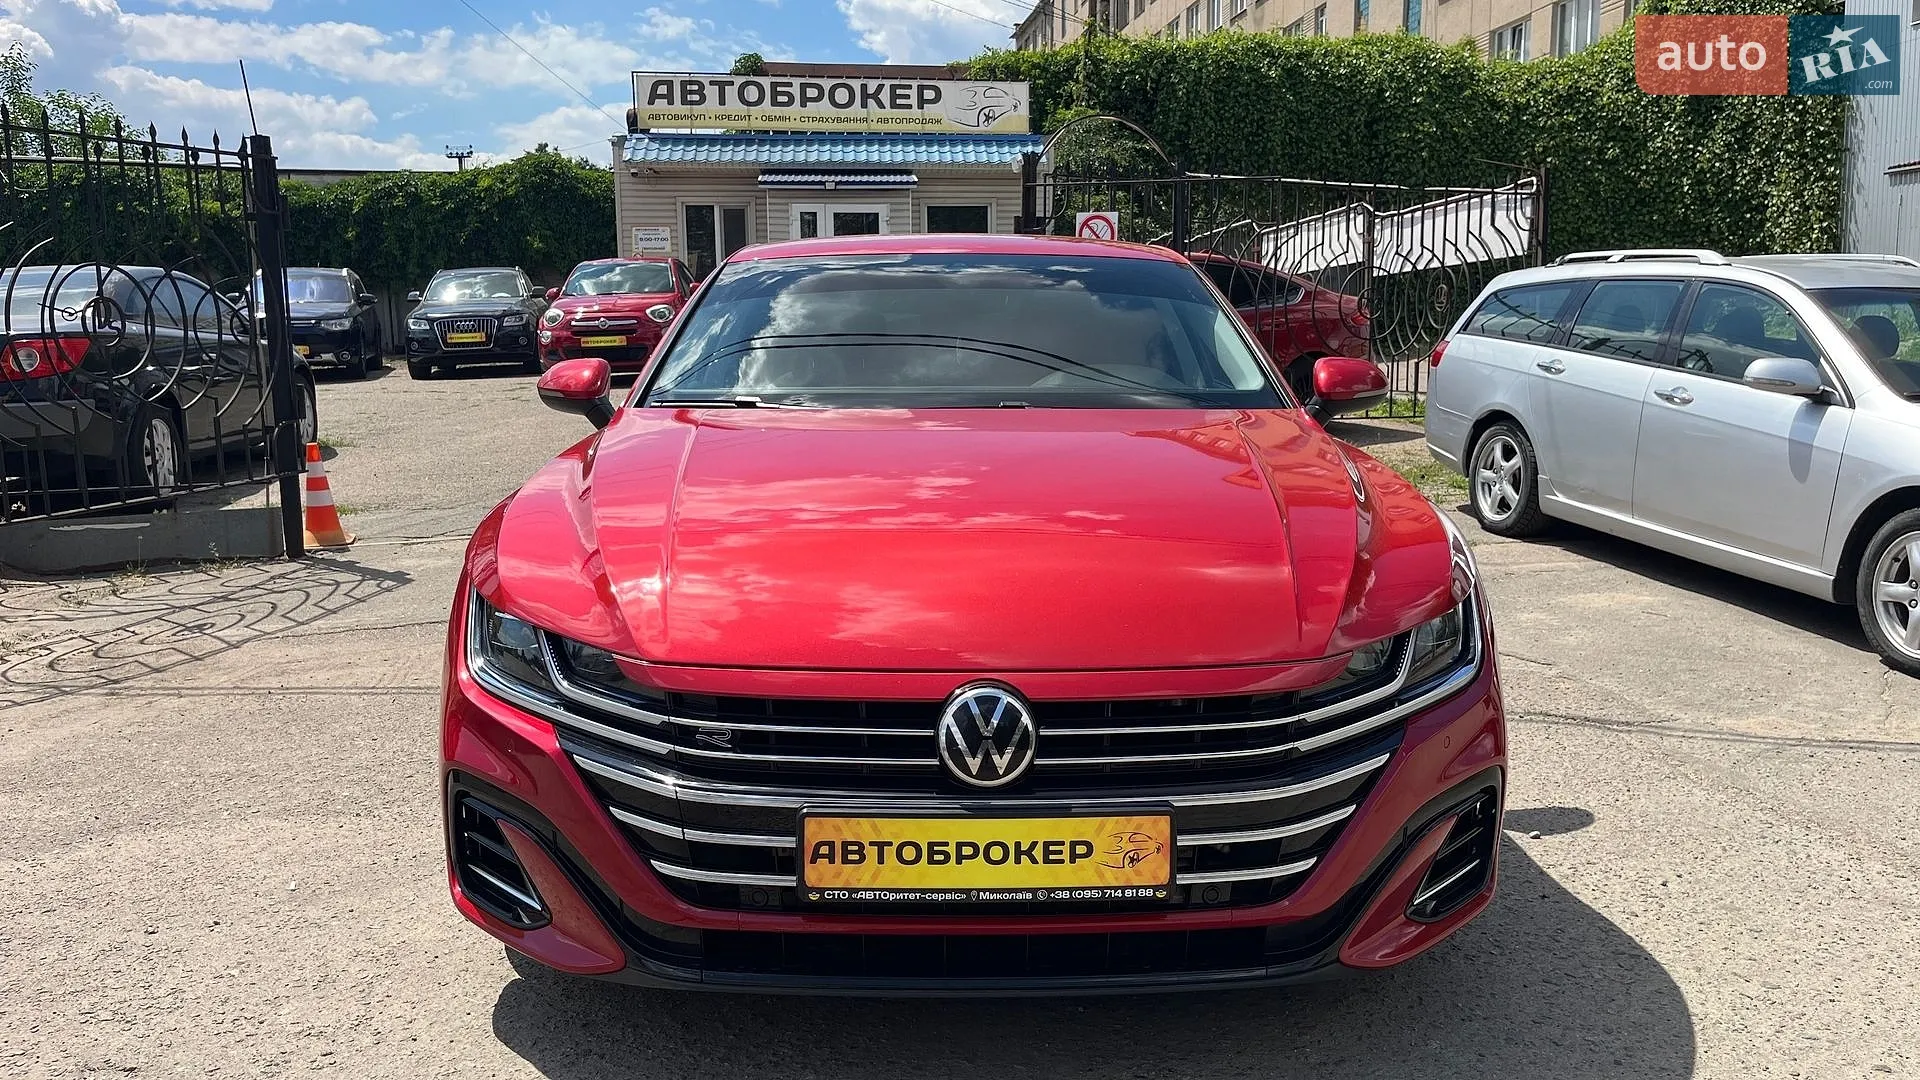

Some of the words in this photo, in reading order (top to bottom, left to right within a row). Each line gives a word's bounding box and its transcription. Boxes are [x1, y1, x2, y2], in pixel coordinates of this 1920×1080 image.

[647, 79, 942, 110] АВТОБРОКЕР
[647, 113, 706, 121] АВТОВИКУП
[714, 114, 752, 122] КРЕДИТ
[760, 115, 791, 123] ОБМІН
[799, 116, 868, 124] СТРАХУВАННЯ
[876, 117, 943, 125] АВТОПРОДАЖ
[809, 840, 1095, 866] АВТОБРОКЕР
[824, 890, 849, 899] СТО
[979, 890, 1033, 900] Миколаїв
[1049, 890, 1070, 899] +38
[1072, 890, 1102, 899] (095)
[1104, 889, 1122, 898] 714
